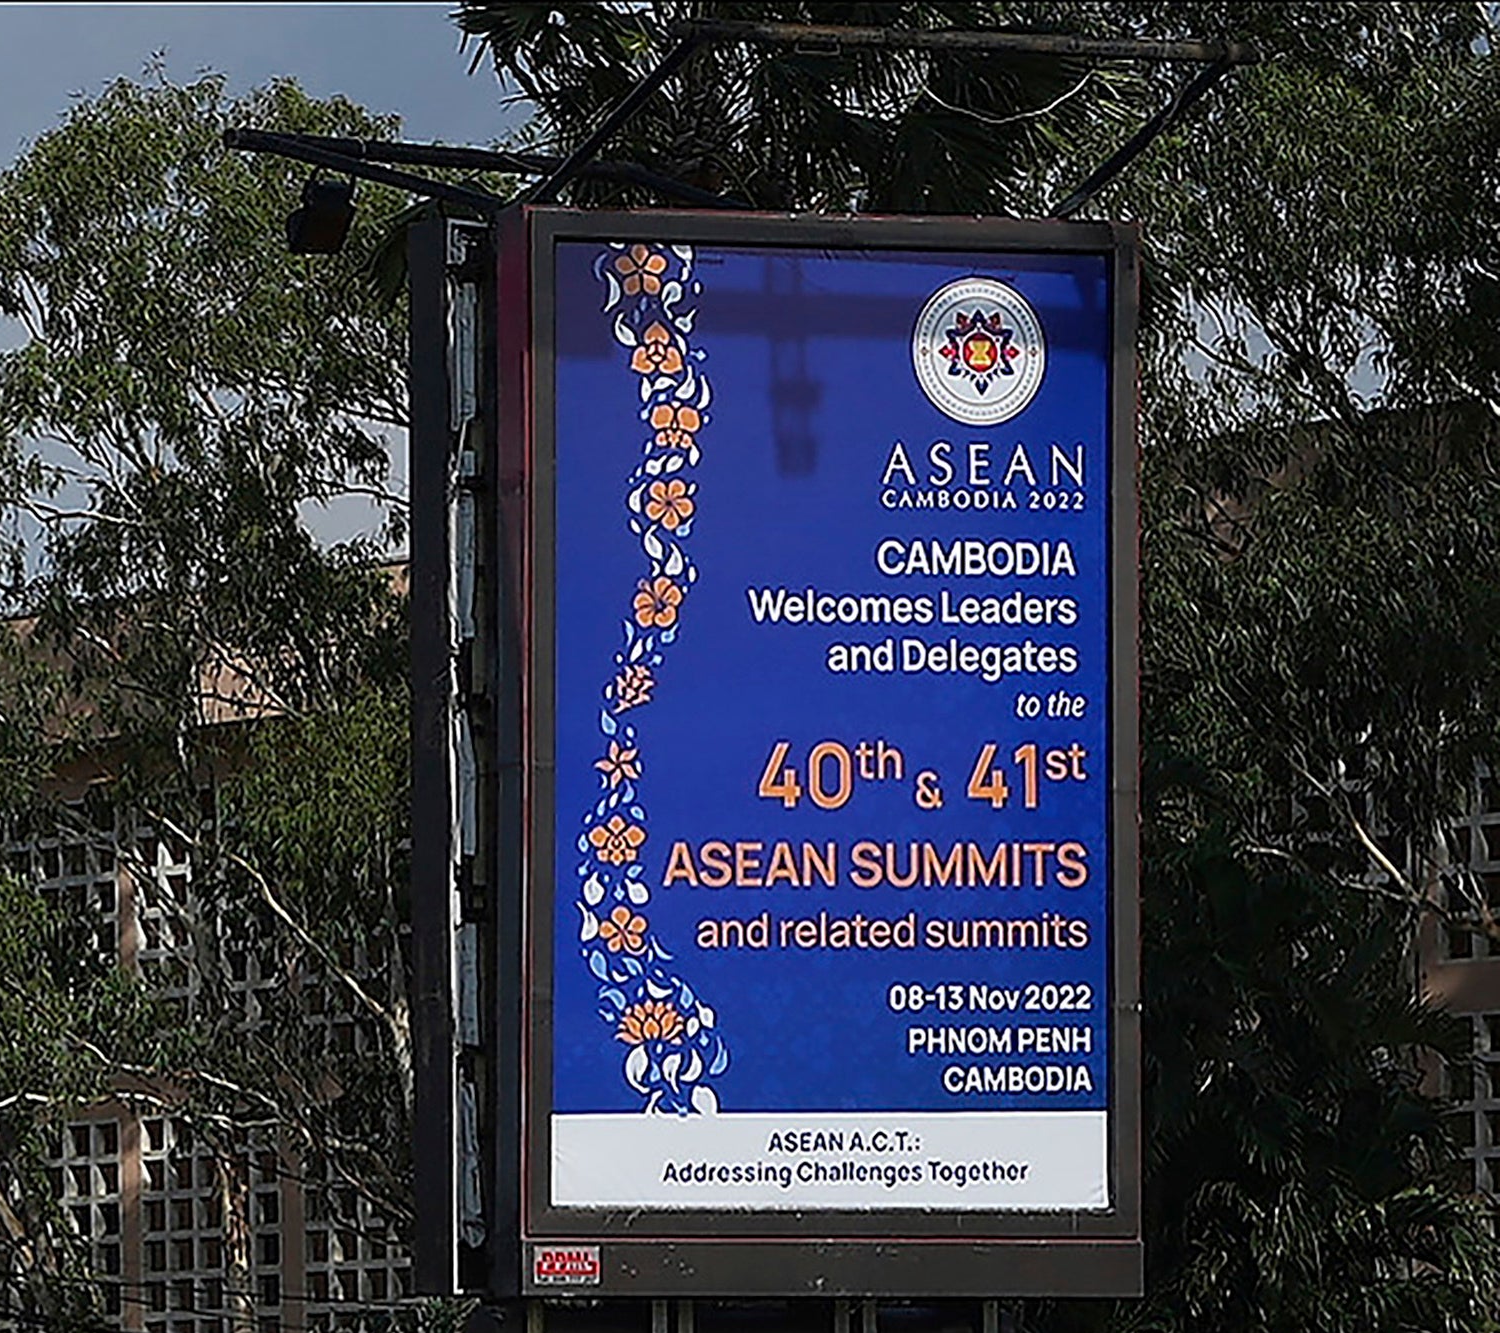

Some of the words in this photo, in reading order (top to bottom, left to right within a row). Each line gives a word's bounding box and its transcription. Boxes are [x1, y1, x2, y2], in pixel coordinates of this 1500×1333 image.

[883, 443, 1082, 486] ASEAN
[882, 490, 1016, 508] CAMBODIA
[1030, 491, 1083, 509] 2022
[878, 541, 1075, 575] CAMBODIA
[749, 590, 933, 623] Welcomes
[942, 591, 1076, 624] Leaders
[829, 639, 893, 671] and
[903, 639, 1076, 681] Delegates
[1017, 695, 1040, 717] to
[1048, 691, 1085, 717] the
[759, 741, 901, 808] 40th
[916, 772, 942, 808] &
[968, 744, 1086, 808] 41st
[664, 842, 835, 886] ASEAN
[851, 842, 1086, 887] SUMMITS
[698, 913, 768, 947] and
[781, 912, 914, 947] related
[926, 913, 1087, 947] summits
[890, 985, 963, 1010] 08-13
[970, 986, 1019, 1010] Nov
[1025, 985, 1090, 1010] 2022
[910, 1028, 1011, 1053] PHNOM
[1018, 1027, 1090, 1052] PENH
[945, 1066, 1092, 1092] CAMBODIA
[769, 1132, 843, 1152] ASEAN
[664, 1162, 791, 1188] Addressing
[797, 1162, 922, 1187] Challenges
[928, 1162, 1027, 1187] Together
